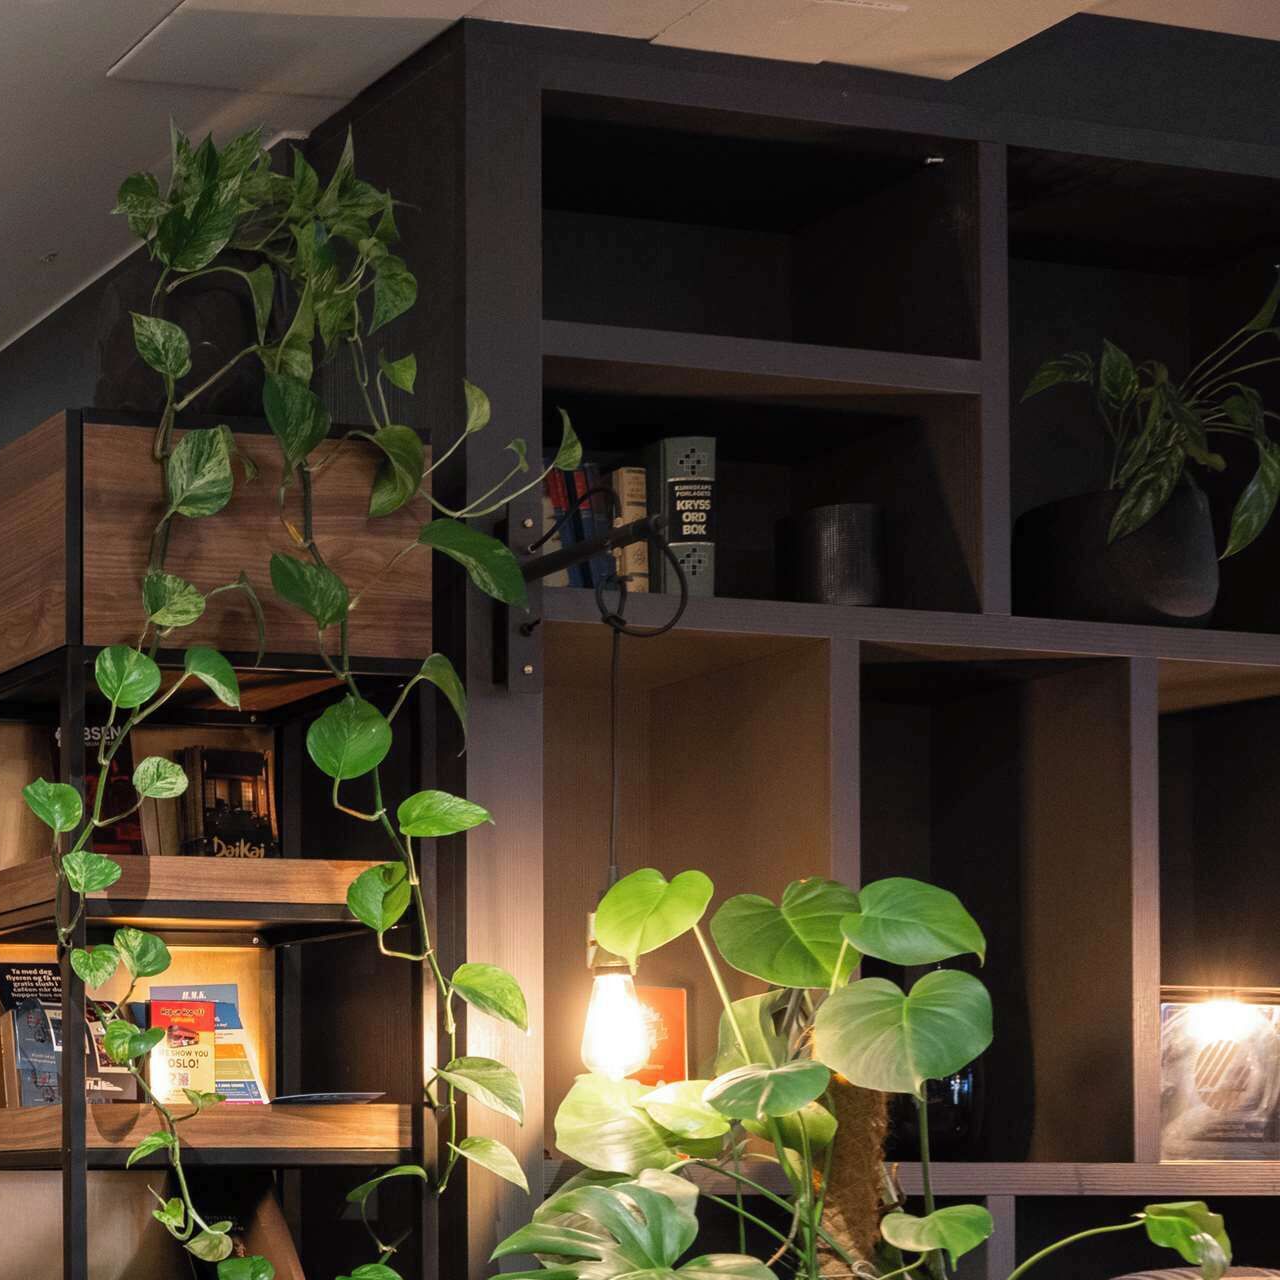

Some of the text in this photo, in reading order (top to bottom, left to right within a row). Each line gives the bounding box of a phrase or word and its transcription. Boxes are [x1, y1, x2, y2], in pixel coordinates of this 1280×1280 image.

[676, 500, 711, 511] KRYSS
[682, 511, 706, 522] ORD
[682, 524, 707, 535] BOK
[83, 726, 121, 741] BSEN
[39, 968, 53, 976] deg
[171, 1049, 192, 1057] SHOW
[194, 1049, 209, 1057] YOU
[167, 1058, 200, 1069] OSLO!
